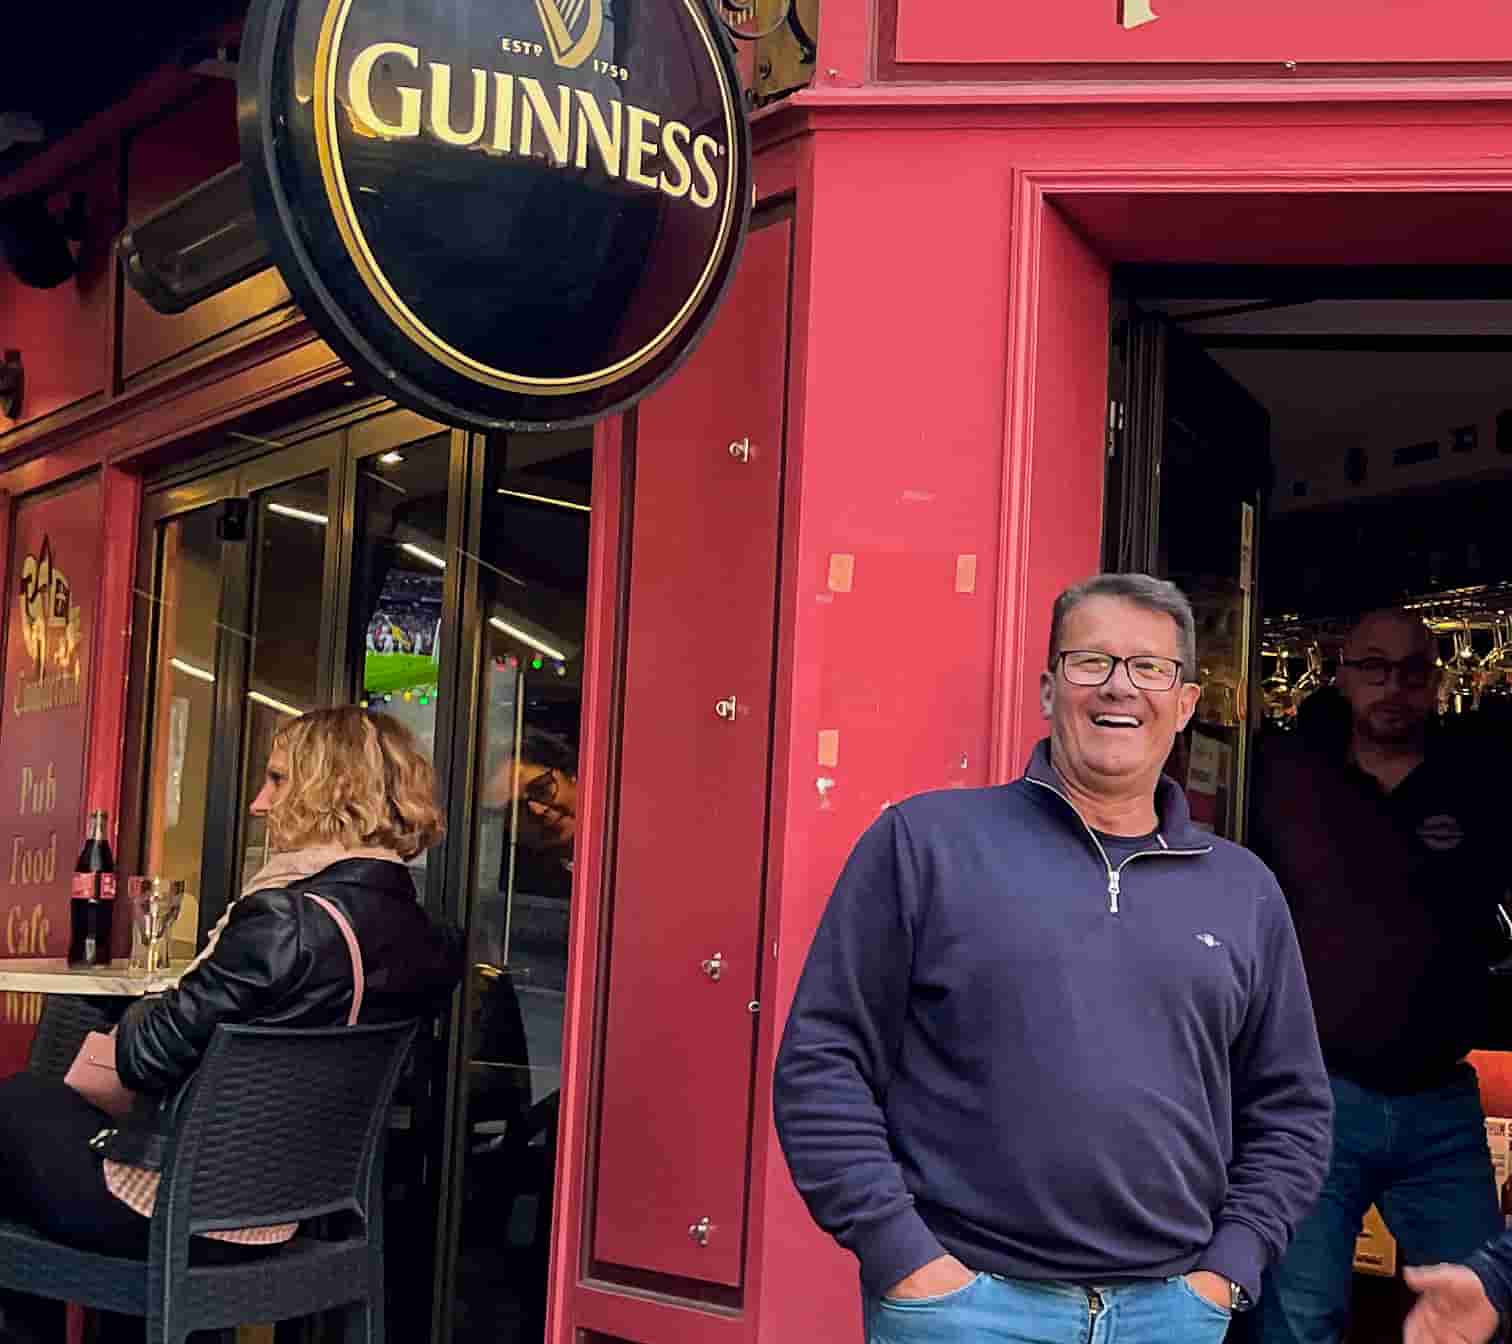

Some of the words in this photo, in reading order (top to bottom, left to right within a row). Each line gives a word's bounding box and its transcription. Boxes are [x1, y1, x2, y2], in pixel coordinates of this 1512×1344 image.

[593, 58, 630, 81] 1759
[347, 42, 728, 209] GUINNESS
[20, 760, 56, 816] Pub
[9, 829, 56, 886] Food
